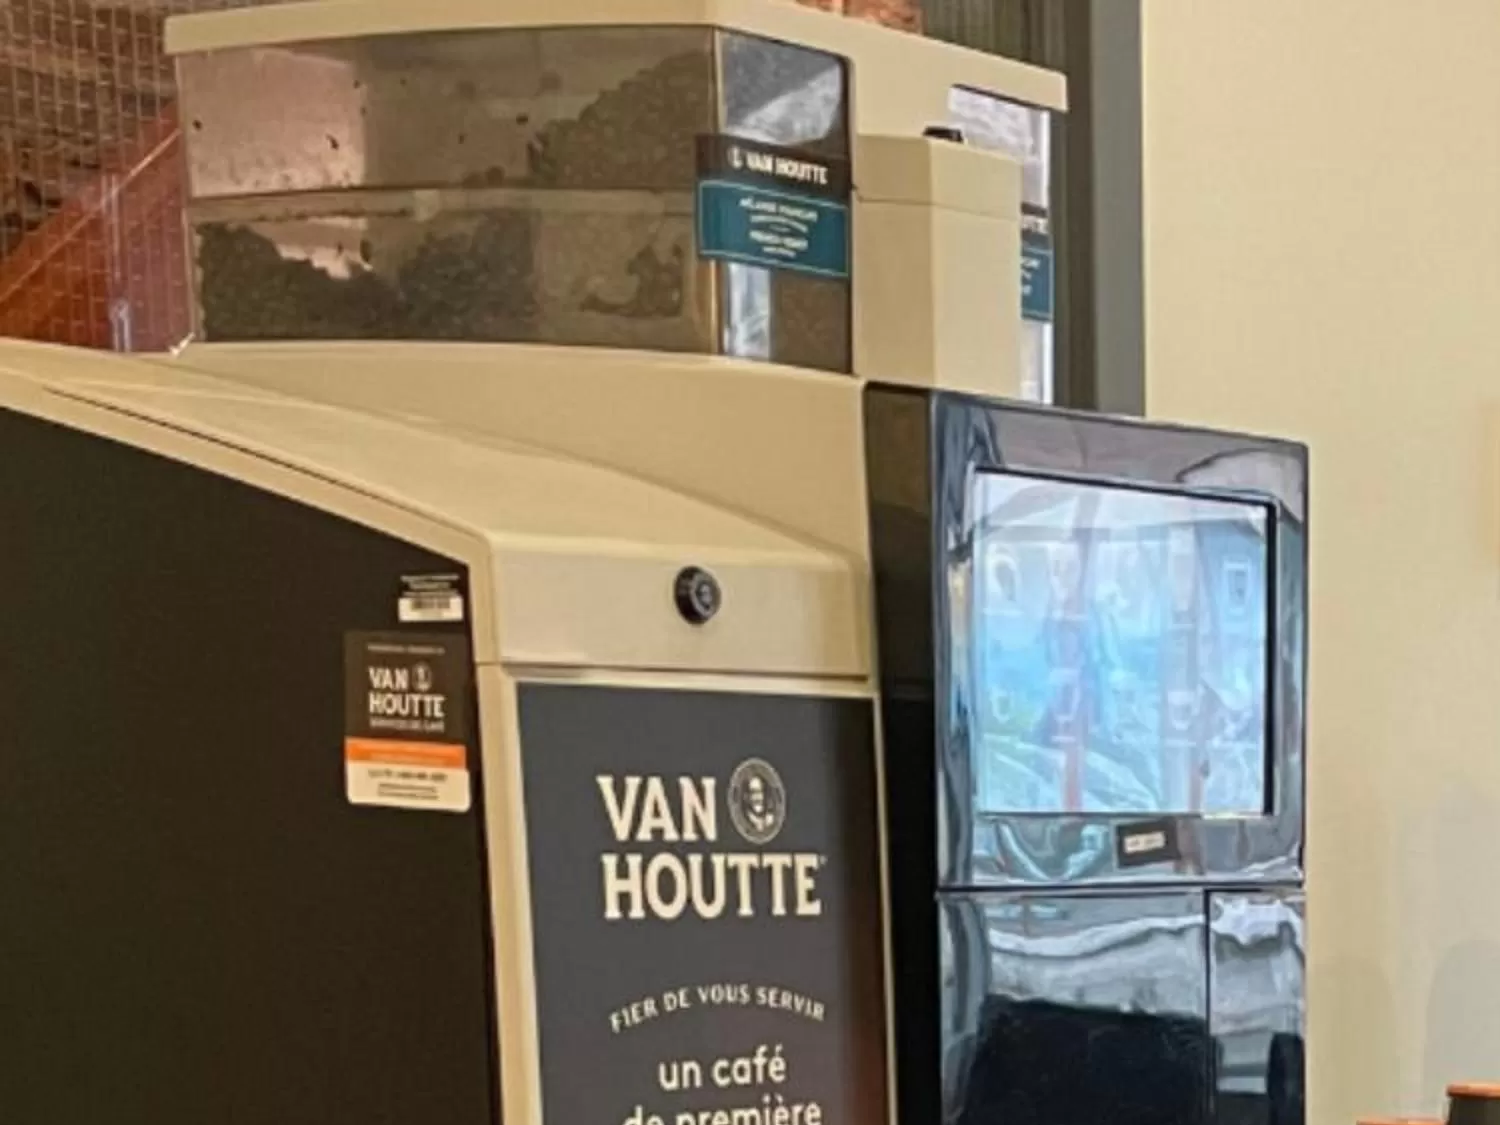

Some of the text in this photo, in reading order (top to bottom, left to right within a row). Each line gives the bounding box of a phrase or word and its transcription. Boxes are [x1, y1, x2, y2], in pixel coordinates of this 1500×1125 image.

[746, 151, 828, 184] VAN HOUTTE
[368, 666, 409, 690] VAN
[368, 691, 446, 718] HOUTTE
[596, 774, 717, 841] VAN
[602, 852, 822, 919] HOUTTE
[608, 983, 826, 1033] FIER DE VOUS SERVIR
[658, 1044, 787, 1090] un café
